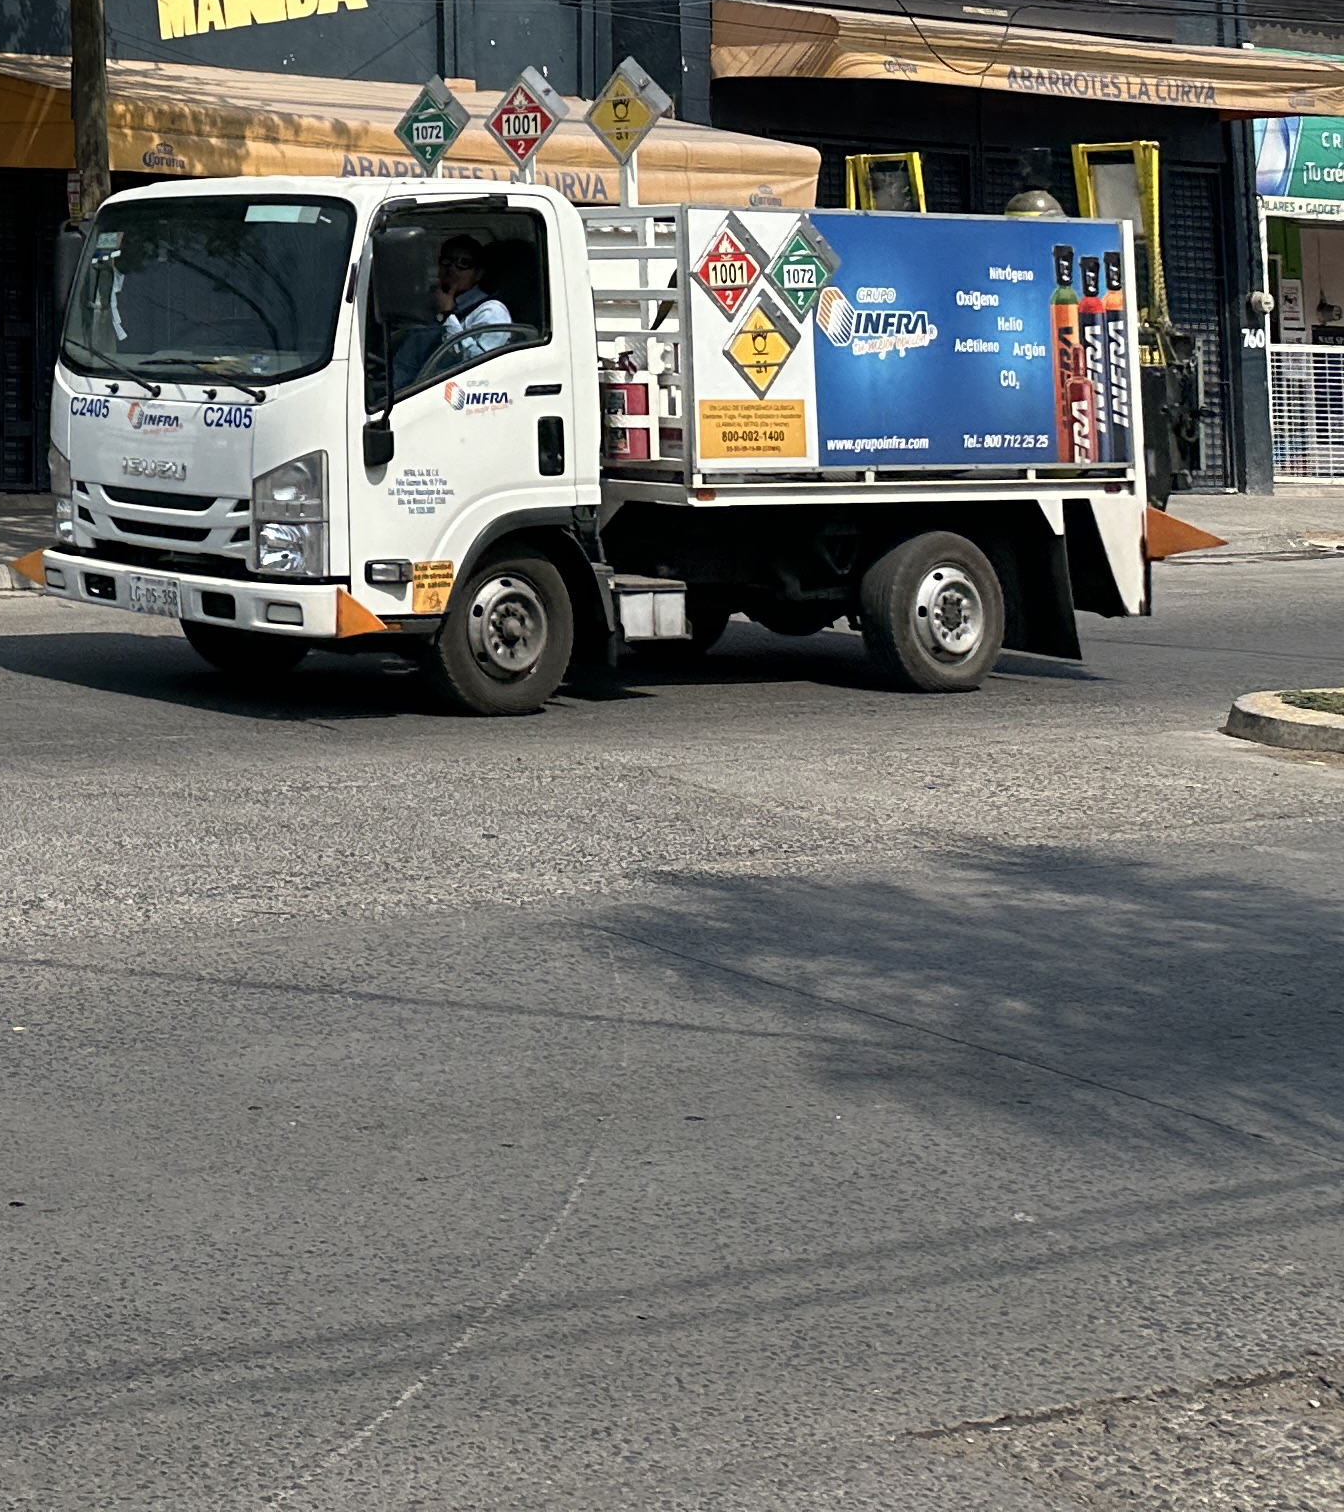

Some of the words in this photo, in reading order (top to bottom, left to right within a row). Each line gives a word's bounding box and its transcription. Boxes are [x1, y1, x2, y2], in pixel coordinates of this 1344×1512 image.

[1007, 66, 1122, 99] ABARROTES
[1126, 75, 1152, 102] LA
[1155, 78, 1217, 105] CURVA
[414, 125, 443, 141] 1072
[504, 114, 539, 135] 1001
[425, 146, 432, 159] 2
[517, 140, 526, 154] 2
[141, 150, 185, 169] Corona
[1303, 162, 1321, 185] ¡Tu
[712, 263, 745, 284] 1001
[786, 268, 814, 284] 1072
[724, 291, 734, 305] 2
[797, 291, 804, 306] 2
[857, 288, 896, 303] GRUPO
[997, 316, 1023, 332] Helio
[1241, 328, 1265, 349] 760
[954, 338, 1000, 354] Acetileno
[1012, 342, 1046, 360] Argón
[465, 392, 509, 405] INFRA
[70, 396, 110, 419] C2405
[143, 414, 180, 427] INFRA
[203, 406, 253, 429] C2405
[721, 430, 785, 442] 800-002-1400
[827, 436, 929, 452] www.grupoinfra.com
[984, 434, 1002, 448] 800
[1003, 434, 1021, 448] 712
[1022, 434, 1035, 448] 25
[1036, 434, 1049, 448] 25
[122, 456, 187, 481] ISUZU
